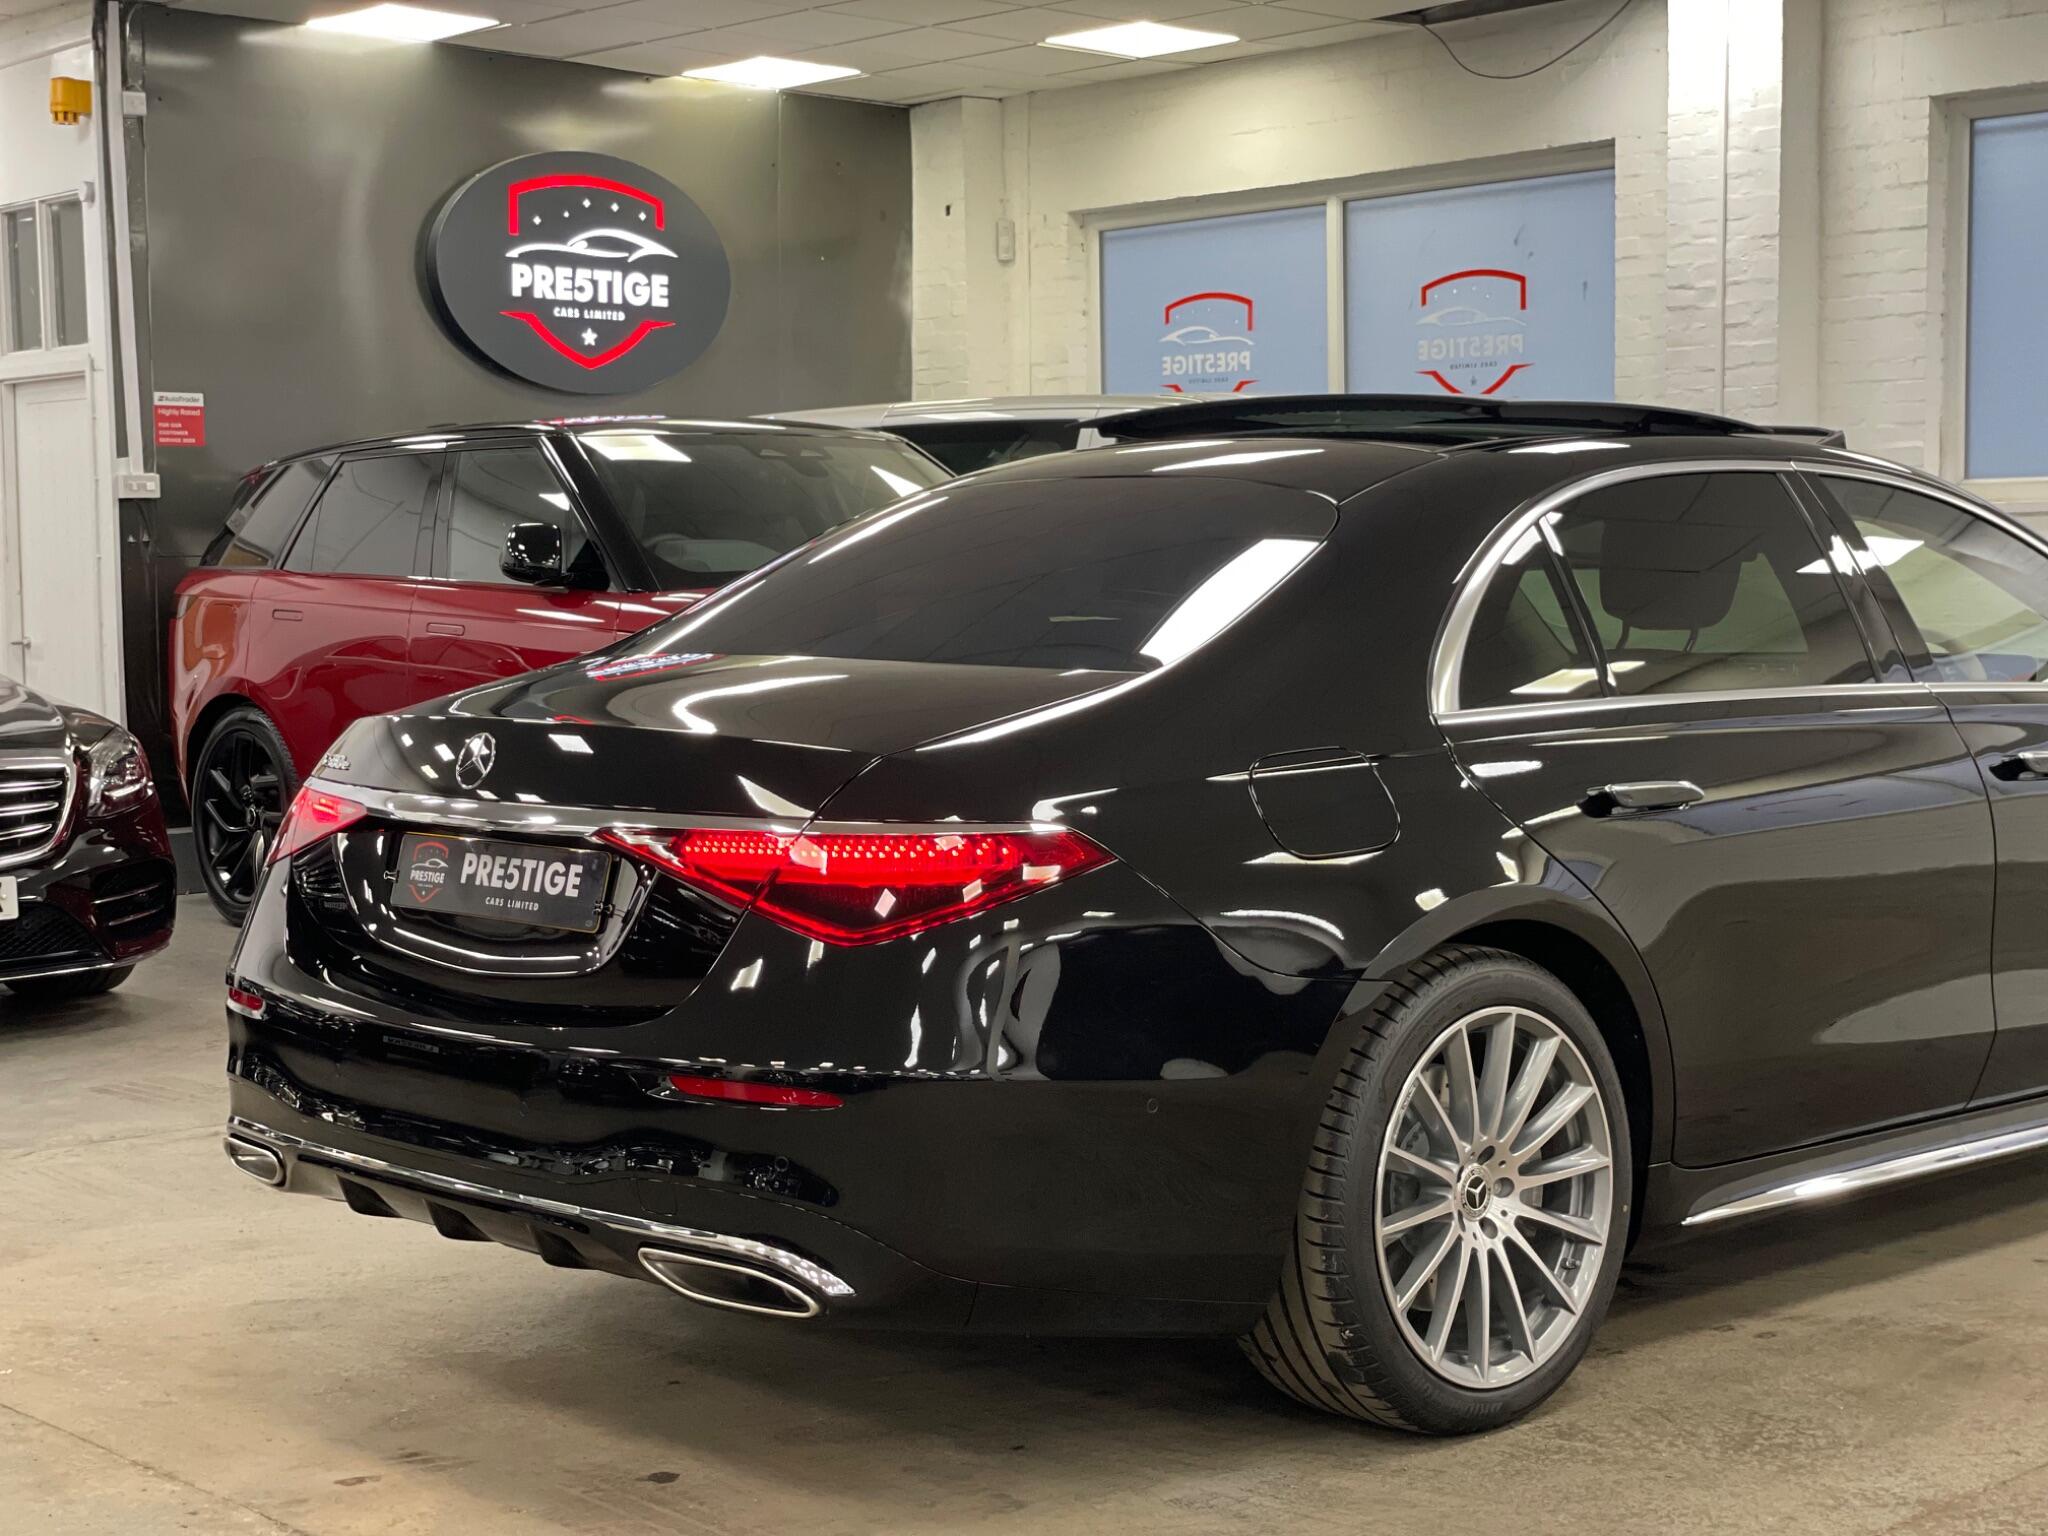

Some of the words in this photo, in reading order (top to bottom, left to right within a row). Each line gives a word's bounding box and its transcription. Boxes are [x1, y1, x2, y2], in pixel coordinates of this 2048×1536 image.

[553, 307, 580, 318] CARS
[583, 309, 626, 321] LIMITED
[485, 896, 504, 908] CARS
[507, 899, 539, 911] LIMITED
